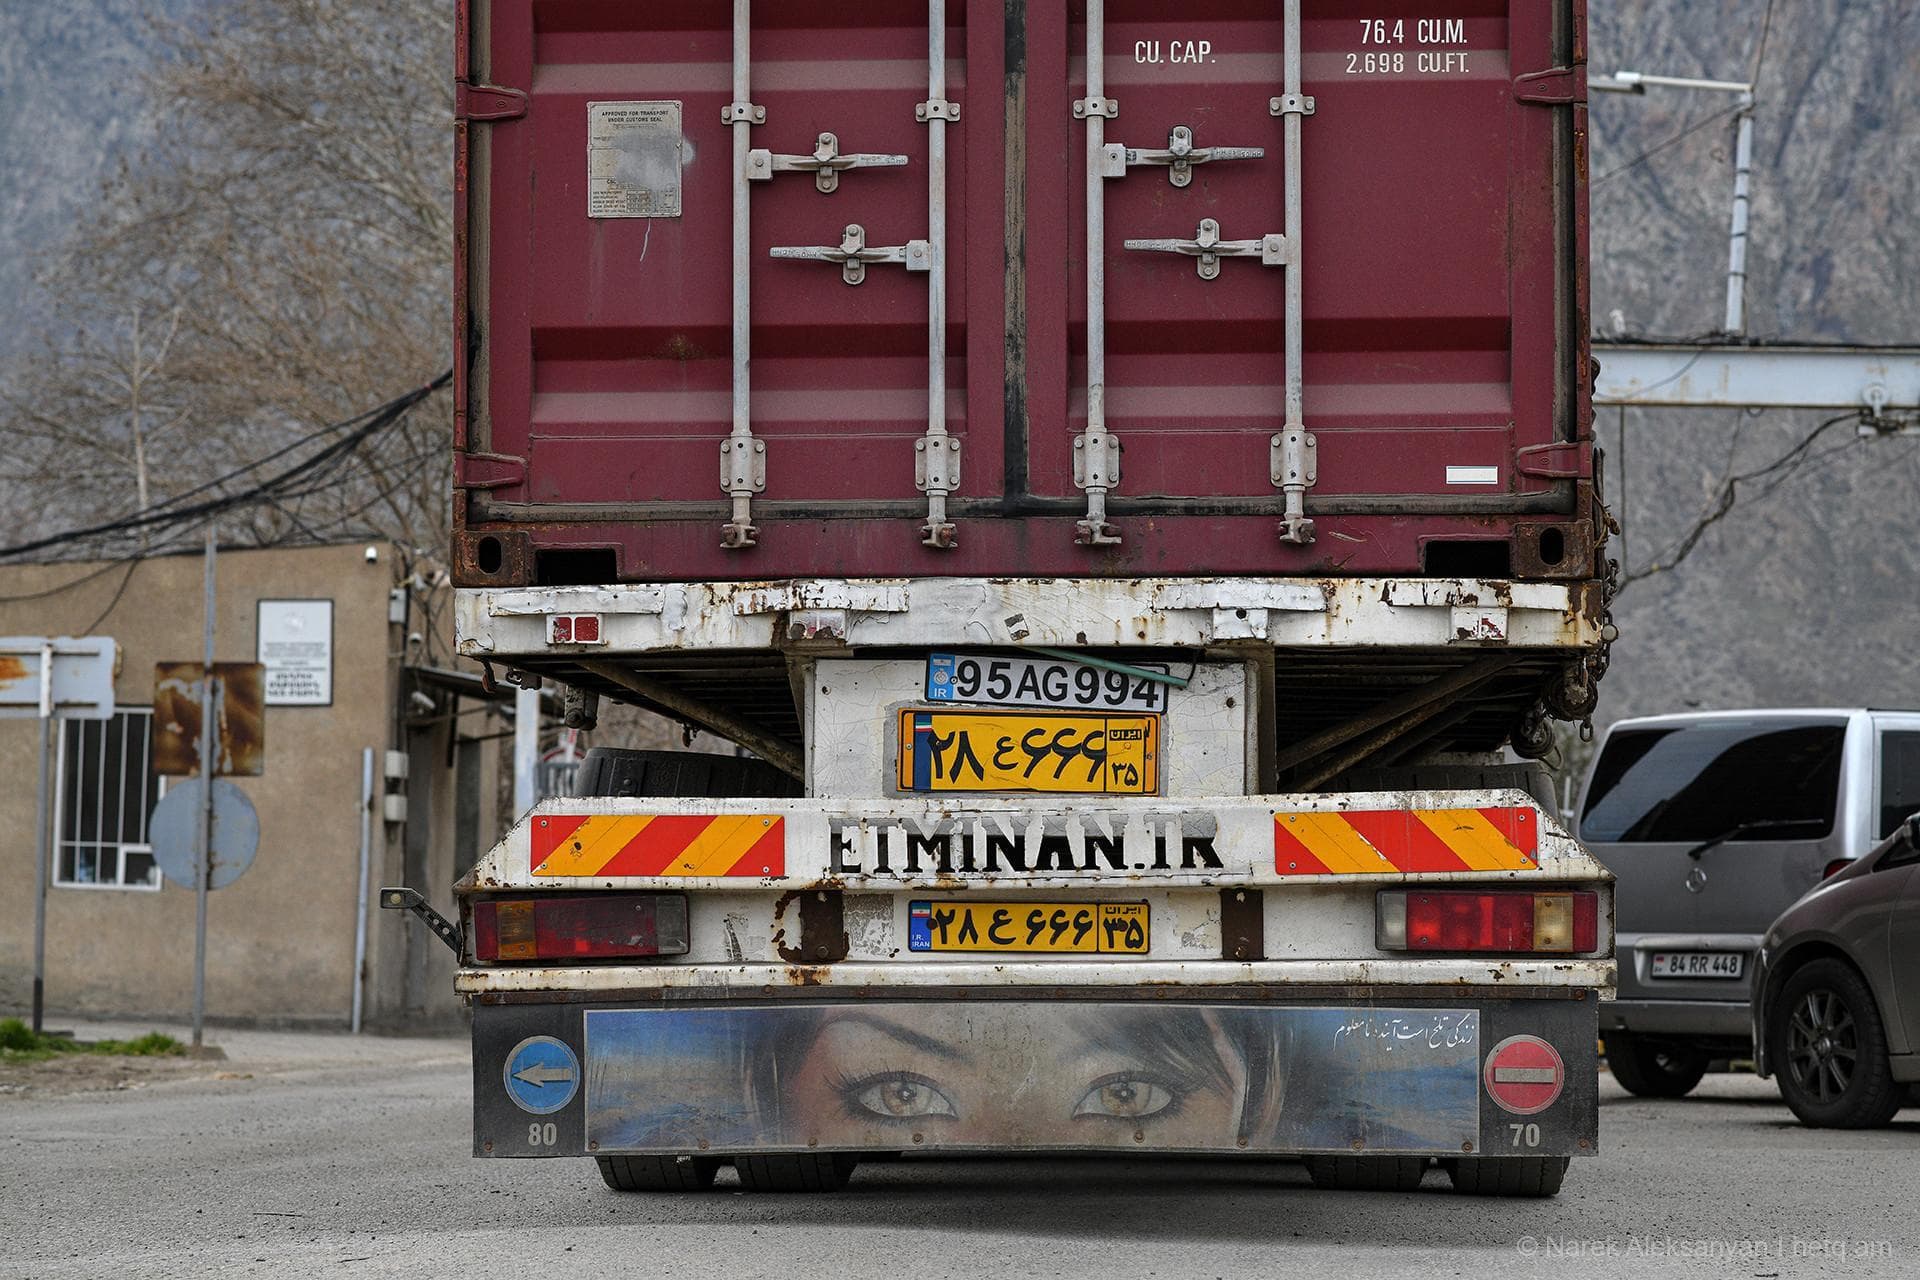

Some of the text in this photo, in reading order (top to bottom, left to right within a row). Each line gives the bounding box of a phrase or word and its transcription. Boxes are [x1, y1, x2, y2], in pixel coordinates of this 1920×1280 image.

[1359, 18, 1468, 44] 76.4 CU.M.
[1133, 40, 1216, 64] CU. CAP.
[1416, 52, 1470, 74] CU.FT.
[934, 687, 947, 699] IR
[956, 659, 1160, 709] 95AG994
[1110, 729, 1141, 740] ایران
[1111, 761, 1139, 787] ۳۵
[1105, 906, 1141, 915] ایران
[1102, 916, 1145, 949] ۳۵
[1669, 955, 1738, 975] 84 RR 448
[527, 1122, 558, 1146] 80
[1509, 1123, 1541, 1147] 70
